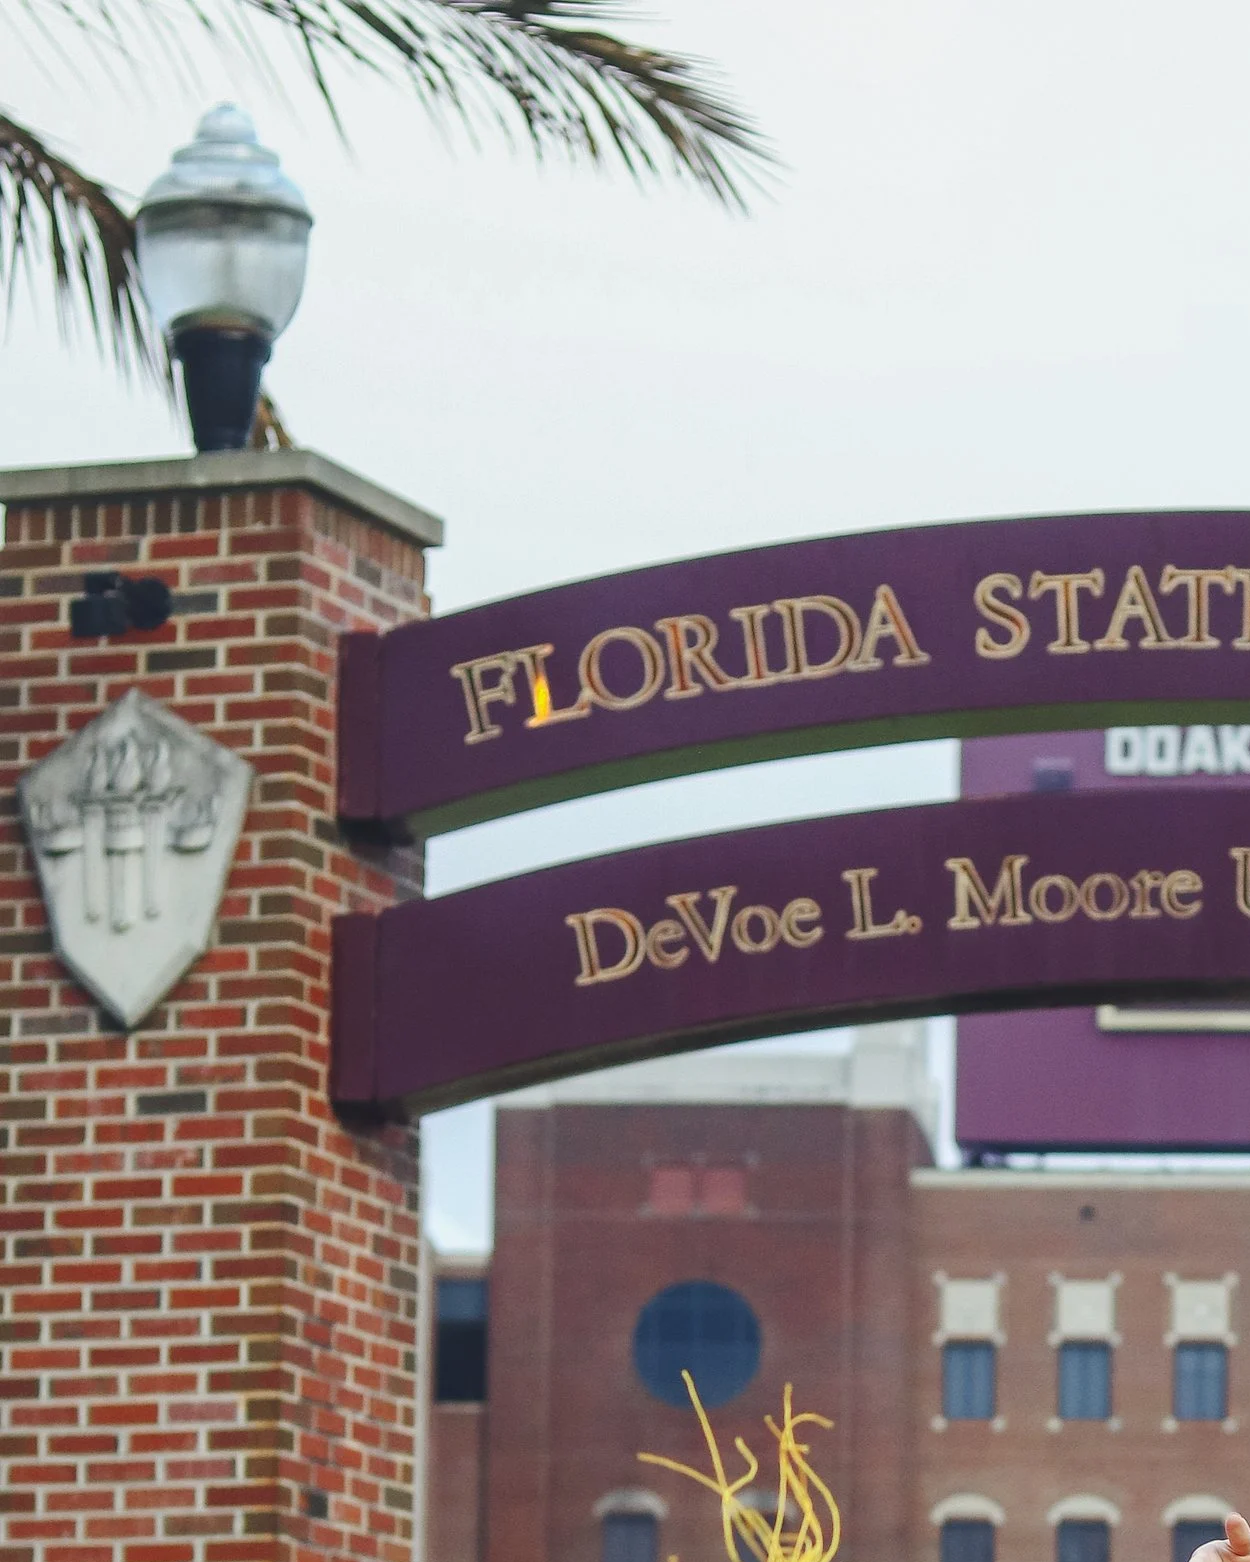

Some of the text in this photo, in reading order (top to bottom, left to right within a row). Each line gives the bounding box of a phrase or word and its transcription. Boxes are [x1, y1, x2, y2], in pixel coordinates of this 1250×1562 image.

[450, 583, 931, 745] FLORIDA
[565, 884, 824, 987] DeVoe
[842, 867, 924, 941] L.
[944, 854, 1205, 932] Moore
